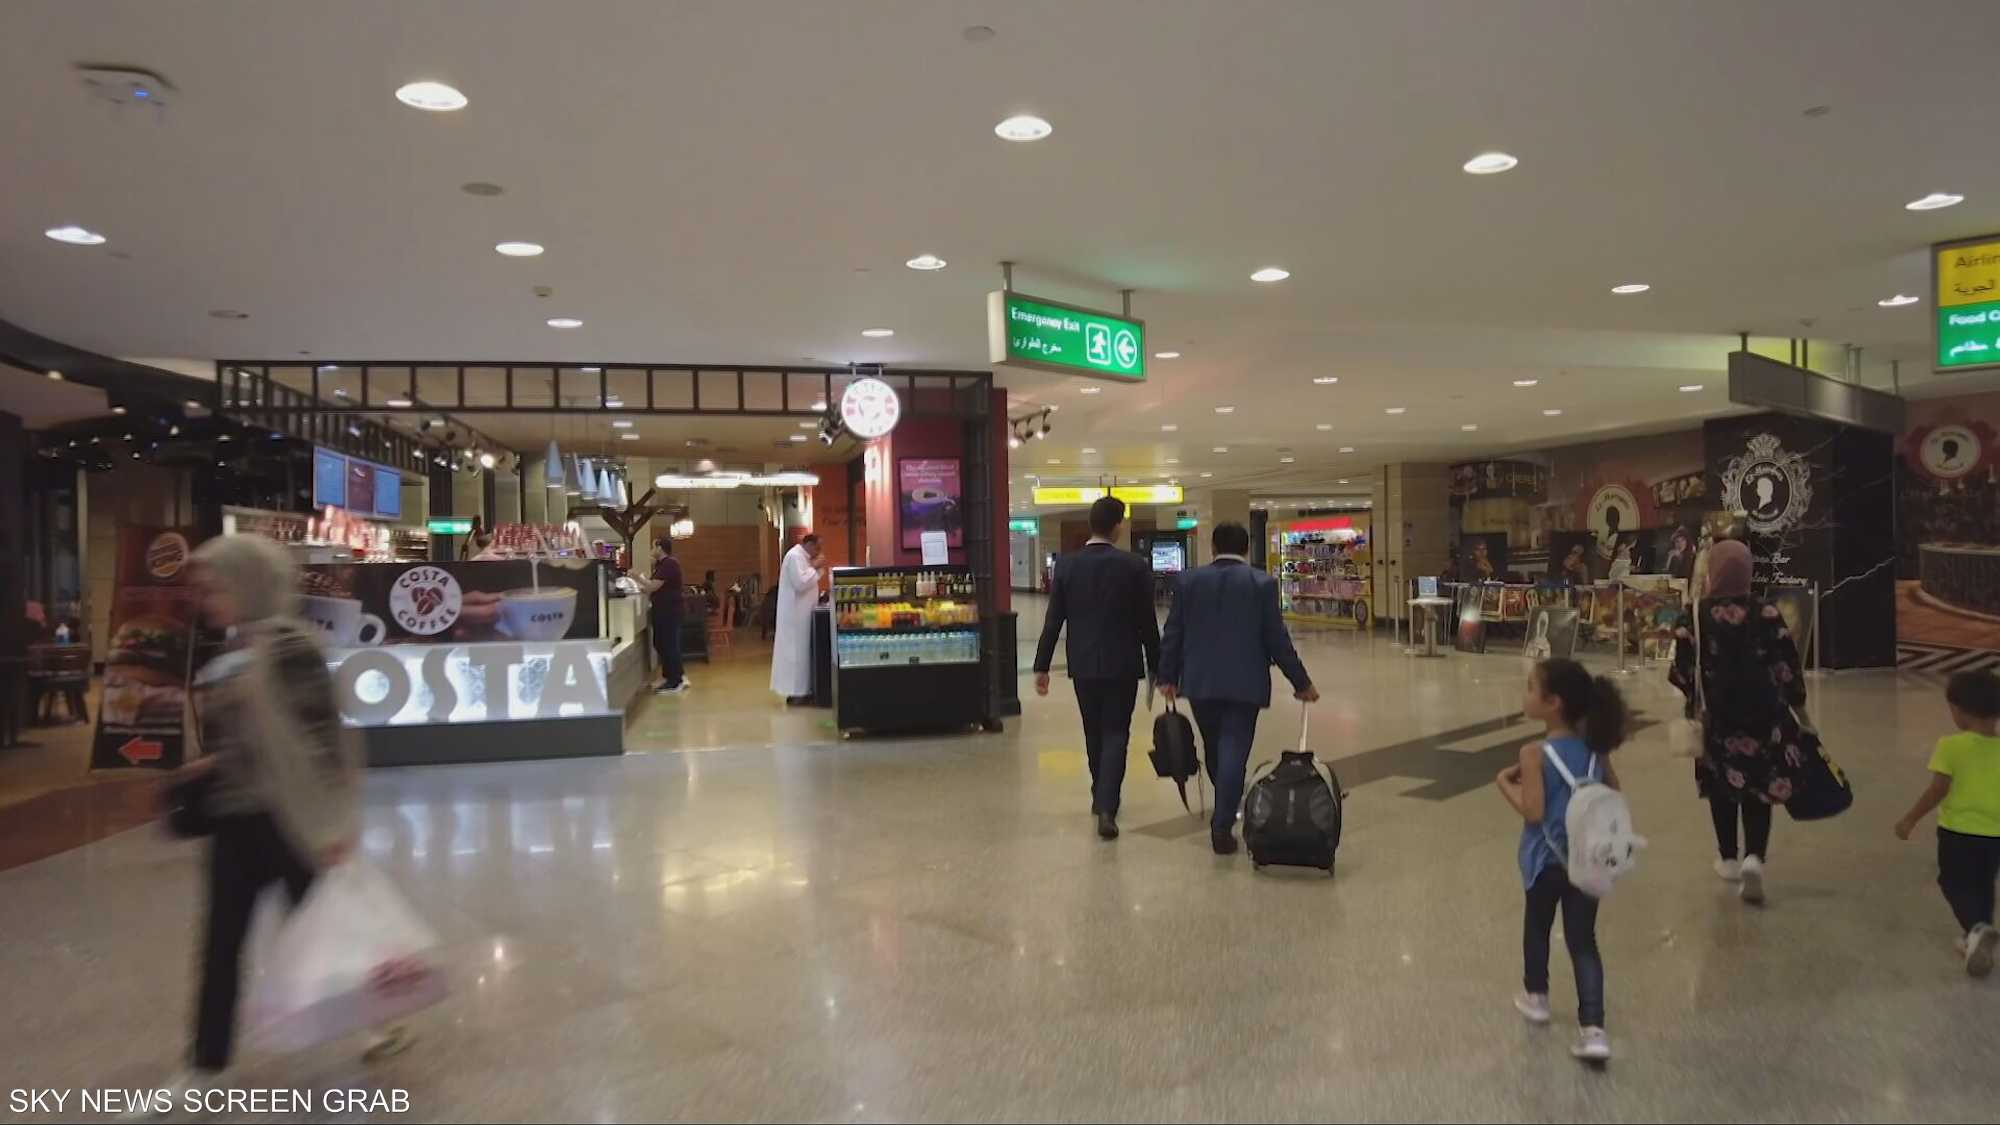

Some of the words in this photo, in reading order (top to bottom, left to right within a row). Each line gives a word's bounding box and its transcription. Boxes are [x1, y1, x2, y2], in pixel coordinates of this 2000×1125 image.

[1011, 307, 1062, 330] Emergency
[1064, 317, 1081, 332] Exit
[1949, 311, 1987, 325] Food
[400, 567, 450, 588] COSTA
[398, 608, 456, 630] COFFEE
[530, 612, 564, 623] COSTA
[334, 645, 610, 726] OSTA
